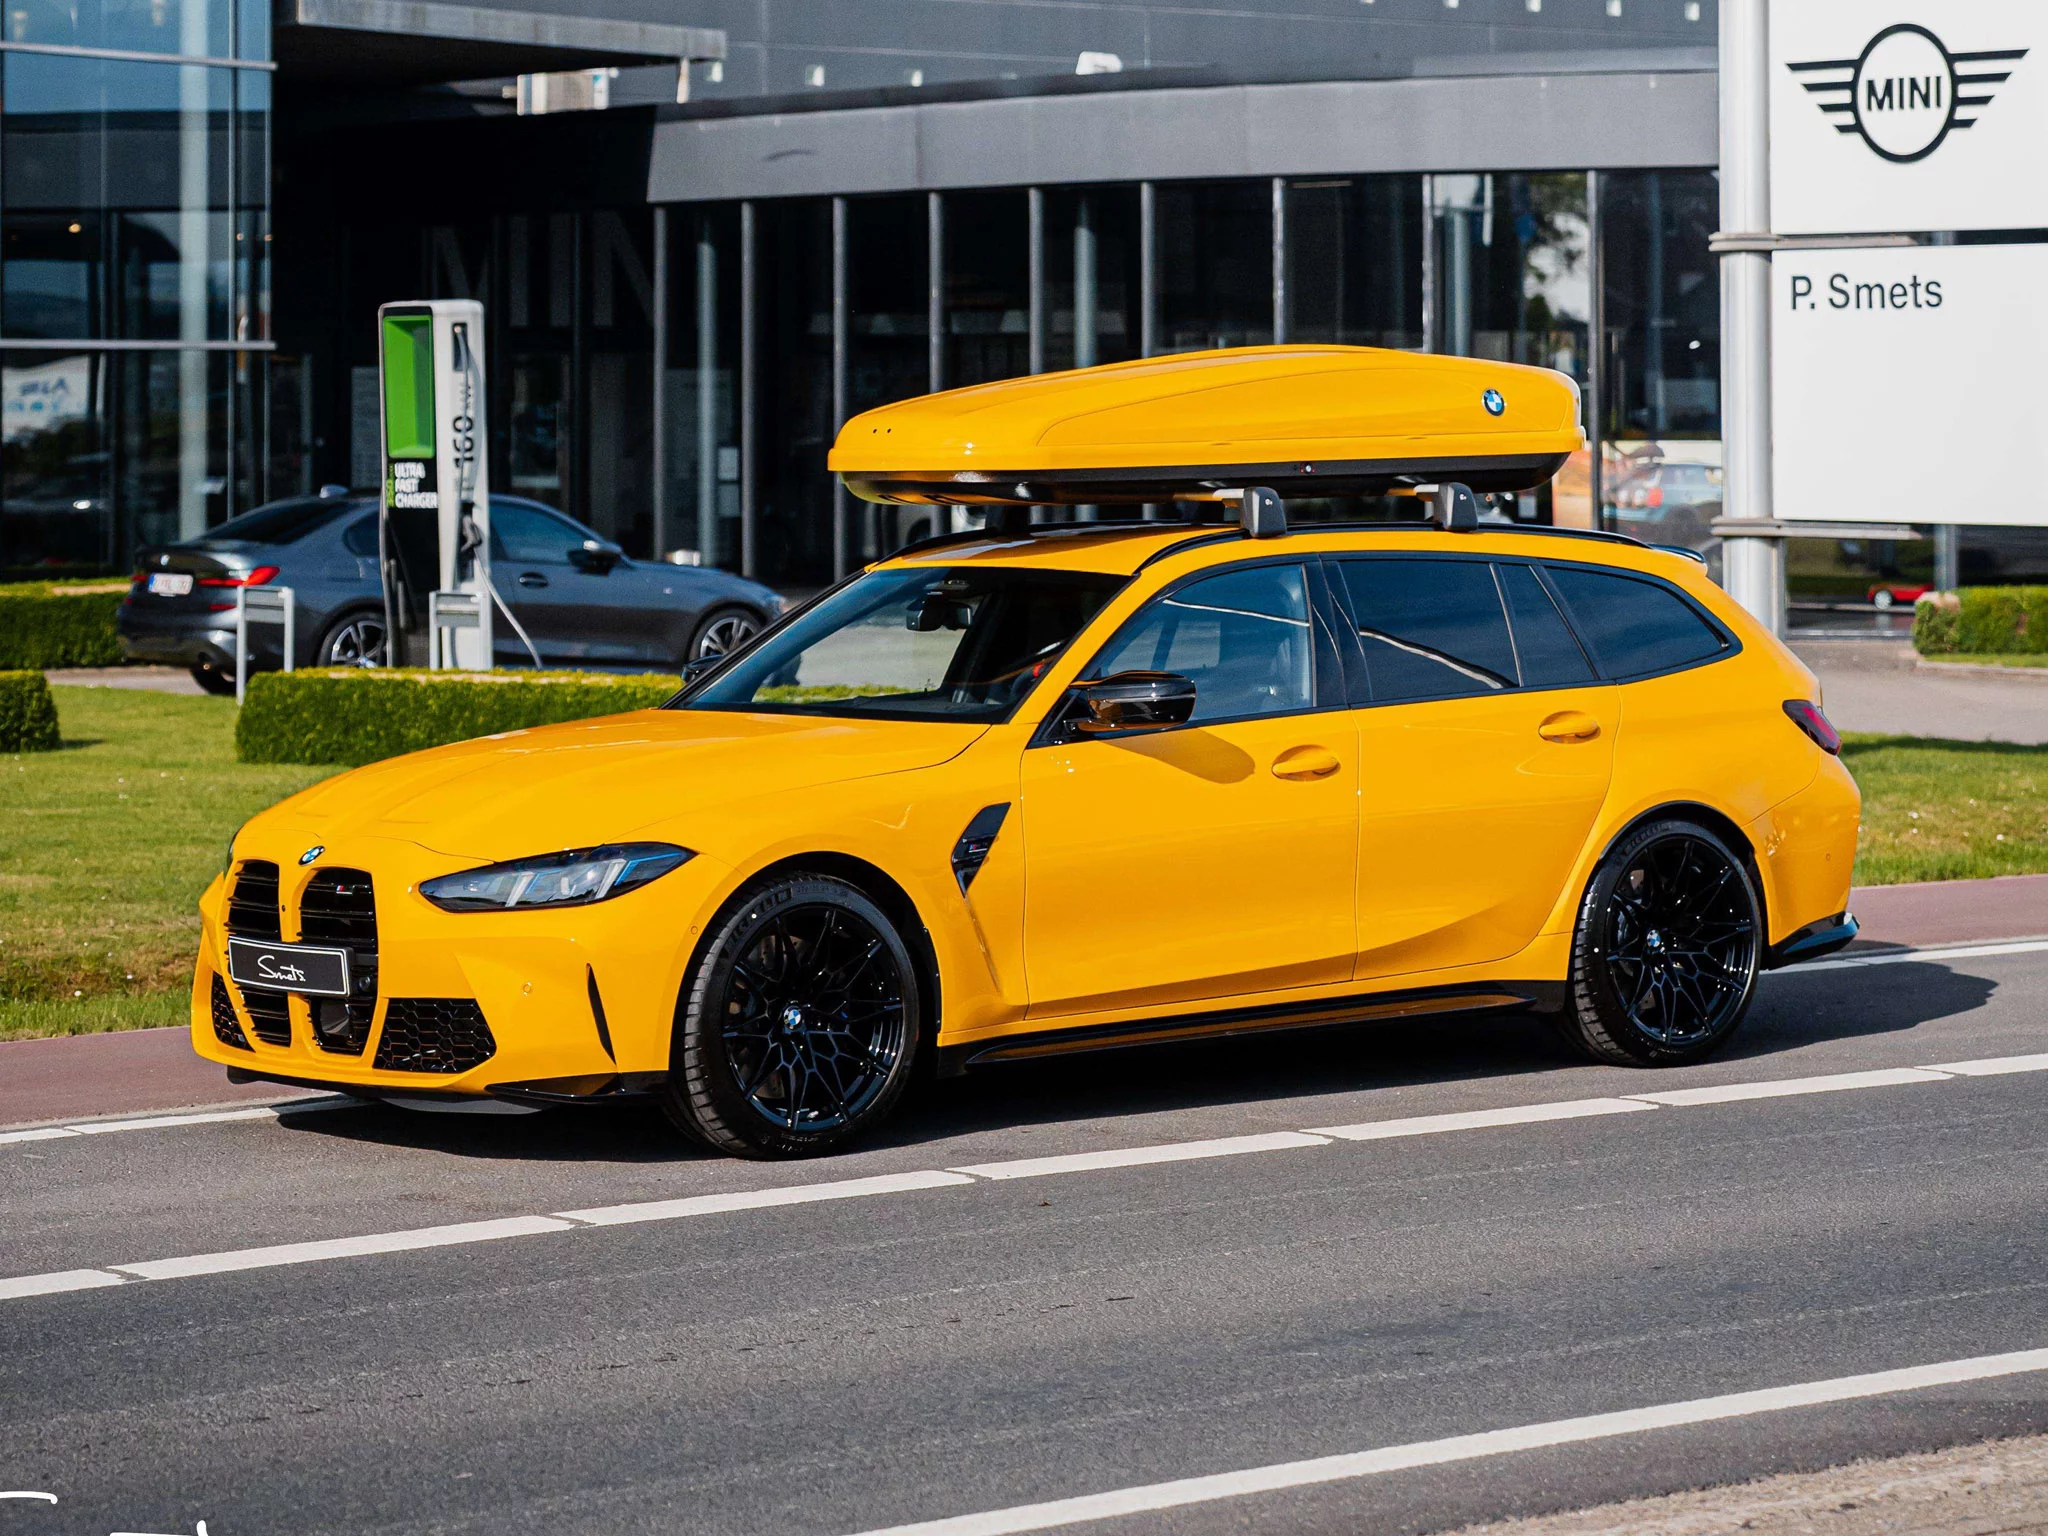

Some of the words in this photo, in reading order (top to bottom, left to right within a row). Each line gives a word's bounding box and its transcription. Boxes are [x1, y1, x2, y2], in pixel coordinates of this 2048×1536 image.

[1866, 75, 1942, 112] MINI
[1791, 275, 1816, 310] P.
[1828, 273, 1943, 310] Smets
[453, 415, 474, 468] 160
